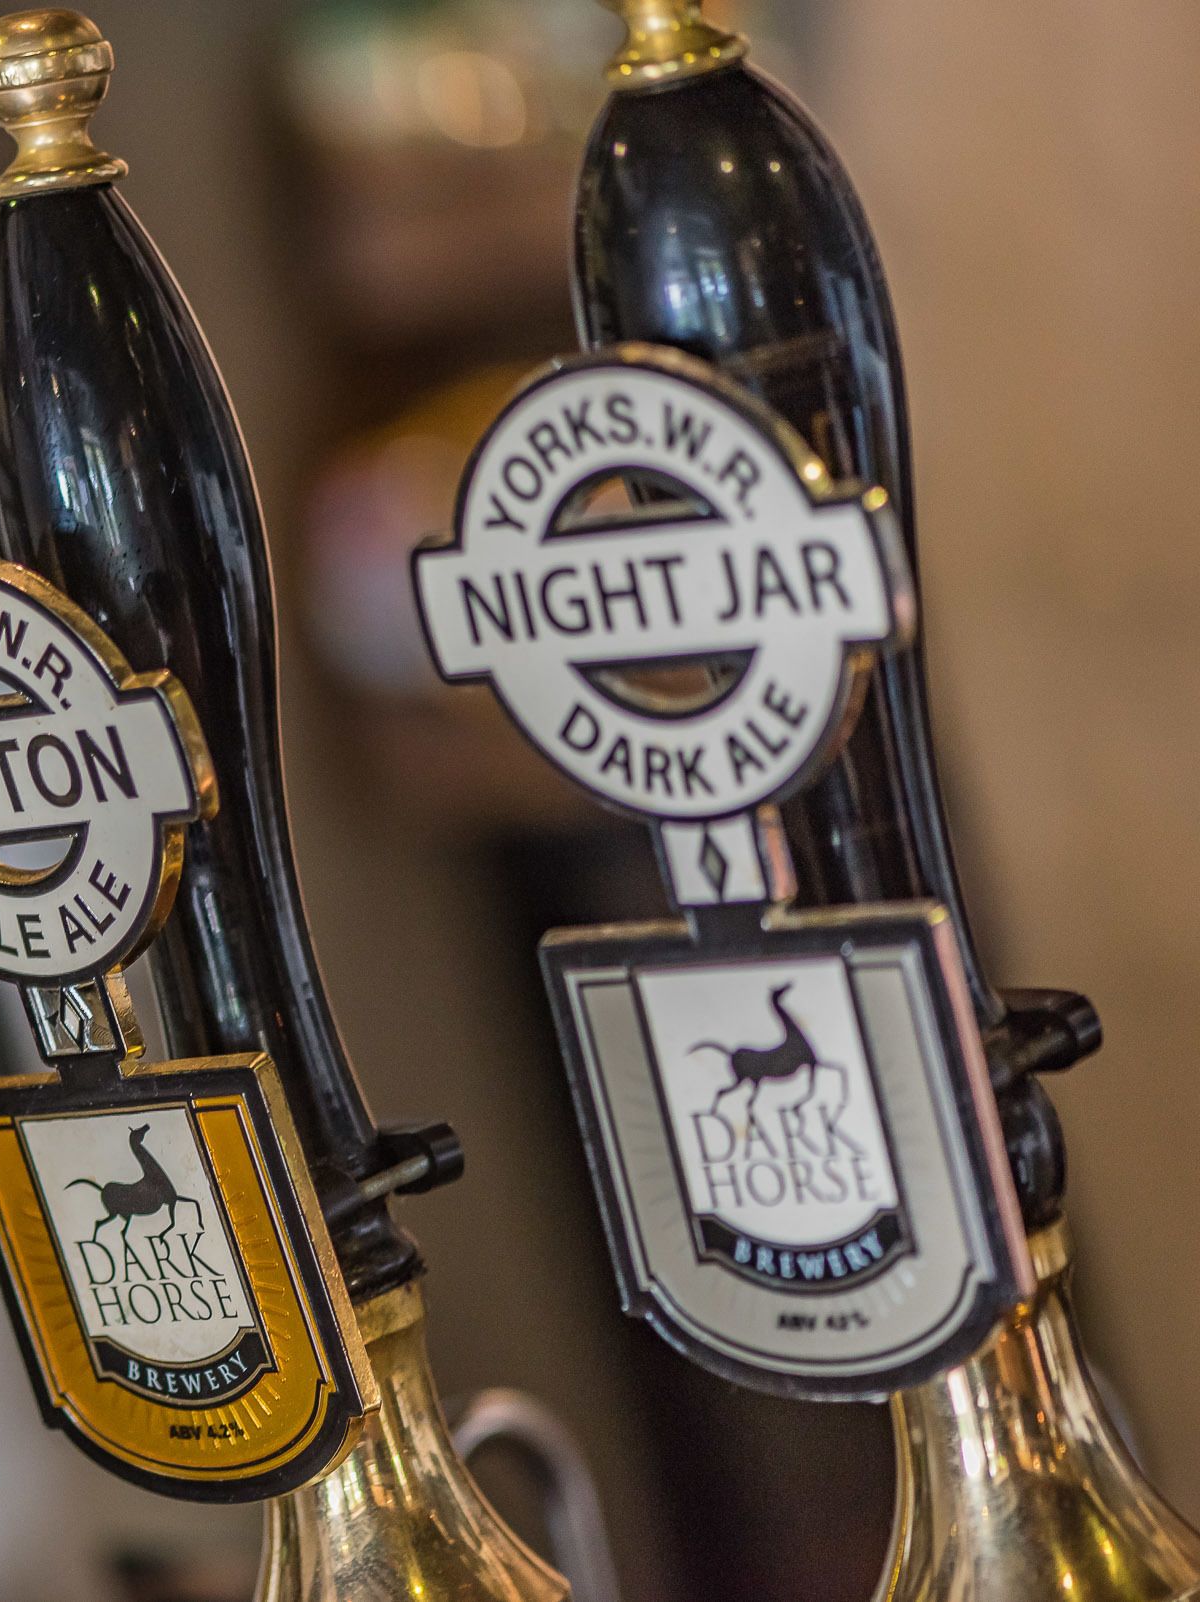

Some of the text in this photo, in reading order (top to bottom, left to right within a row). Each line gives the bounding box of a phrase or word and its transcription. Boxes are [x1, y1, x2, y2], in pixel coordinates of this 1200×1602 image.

[457, 539, 853, 647] NIGHT JAR
[558, 682, 809, 797] DARK ALE
[58, 859, 132, 954] ALE
[691, 1102, 861, 1165] DARK
[703, 1155, 882, 1209] HORSE
[74, 1231, 225, 1286] DARK
[734, 1227, 884, 1280] BREWERY
[89, 1278, 240, 1328] HORSE
[126, 1350, 248, 1395] BREWERY
[169, 1425, 201, 1440] ABV
